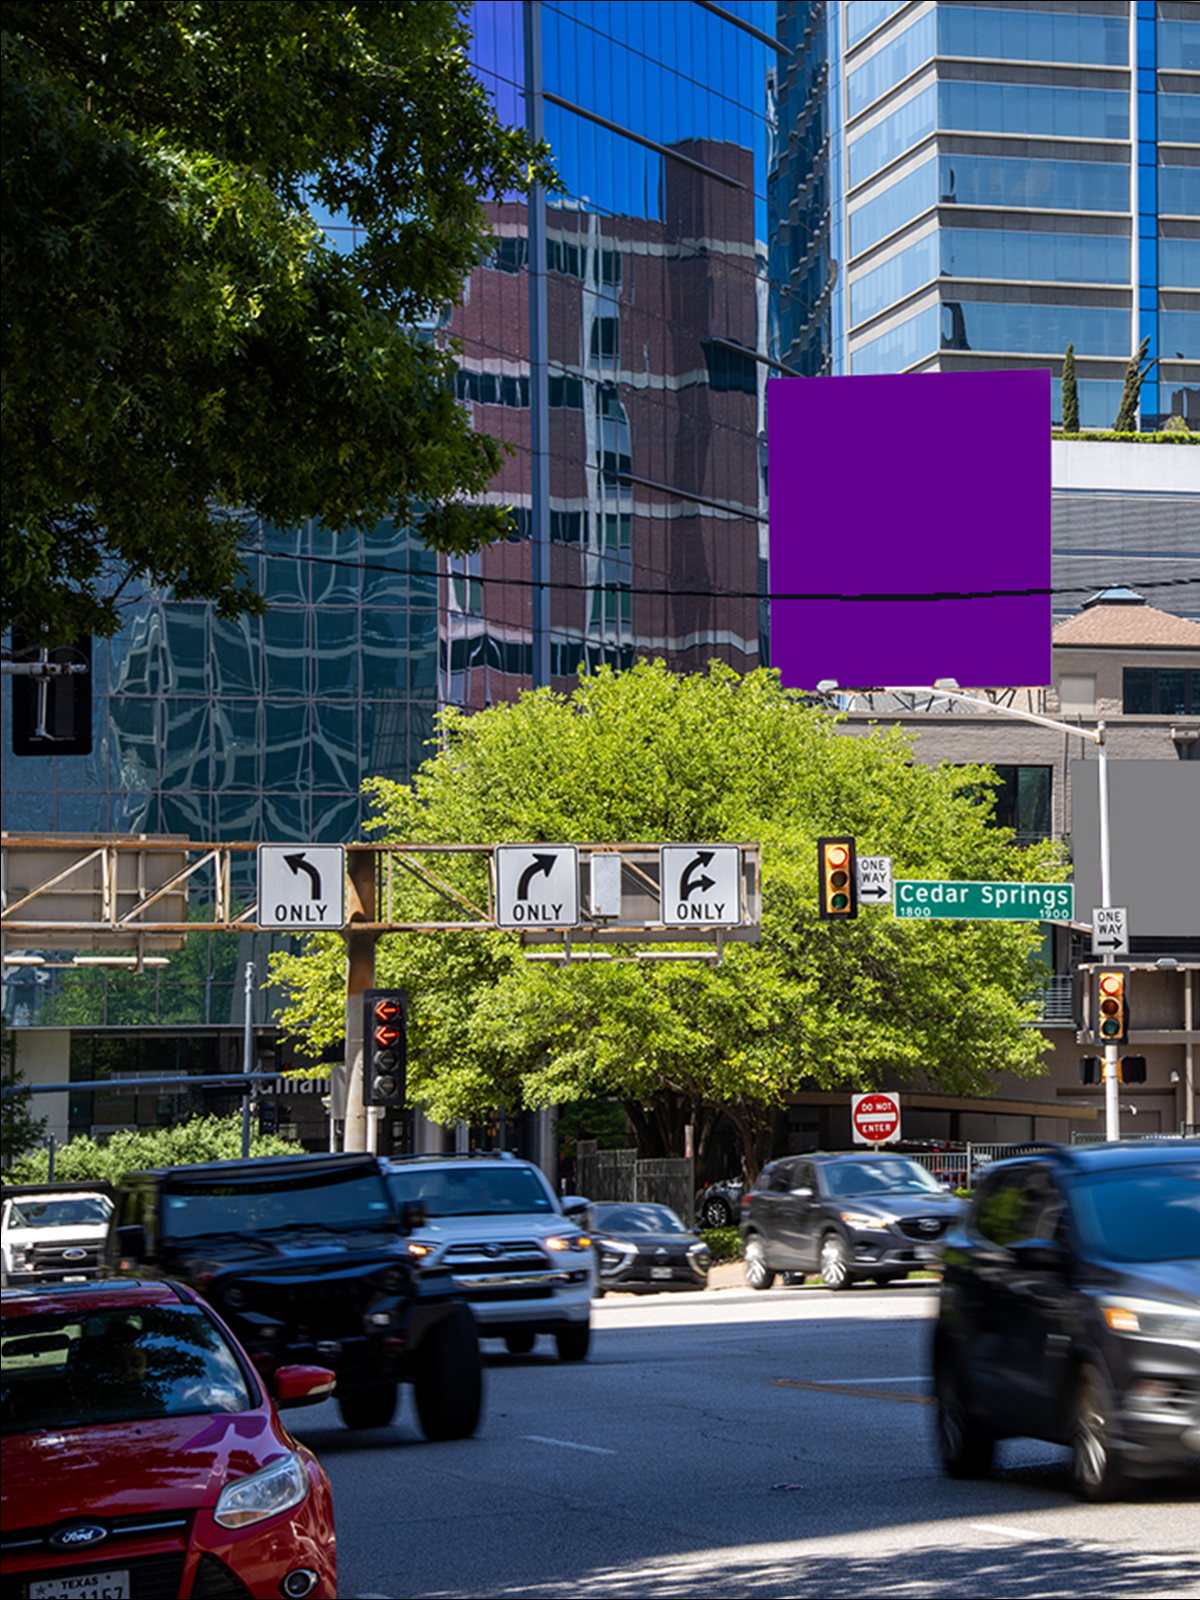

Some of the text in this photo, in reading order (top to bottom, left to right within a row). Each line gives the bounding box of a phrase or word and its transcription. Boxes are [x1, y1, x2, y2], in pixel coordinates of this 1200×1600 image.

[861, 859, 885, 871] ONE
[861, 872, 887, 883] WAY
[900, 884, 1069, 909] Cedar Springs
[275, 904, 328, 922] ONLY
[512, 904, 563, 921] ONLY
[676, 903, 725, 920] ONLY
[900, 907, 931, 917] 1800
[1039, 909, 1069, 919] 1900
[1097, 911, 1121, 923] ONE
[1098, 923, 1123, 935] WAY
[861, 1102, 892, 1112] DO NOT
[862, 1123, 891, 1133] ENTER
[62, 1528, 94, 1543] Ford
[61, 1576, 99, 1590] TEXAS
